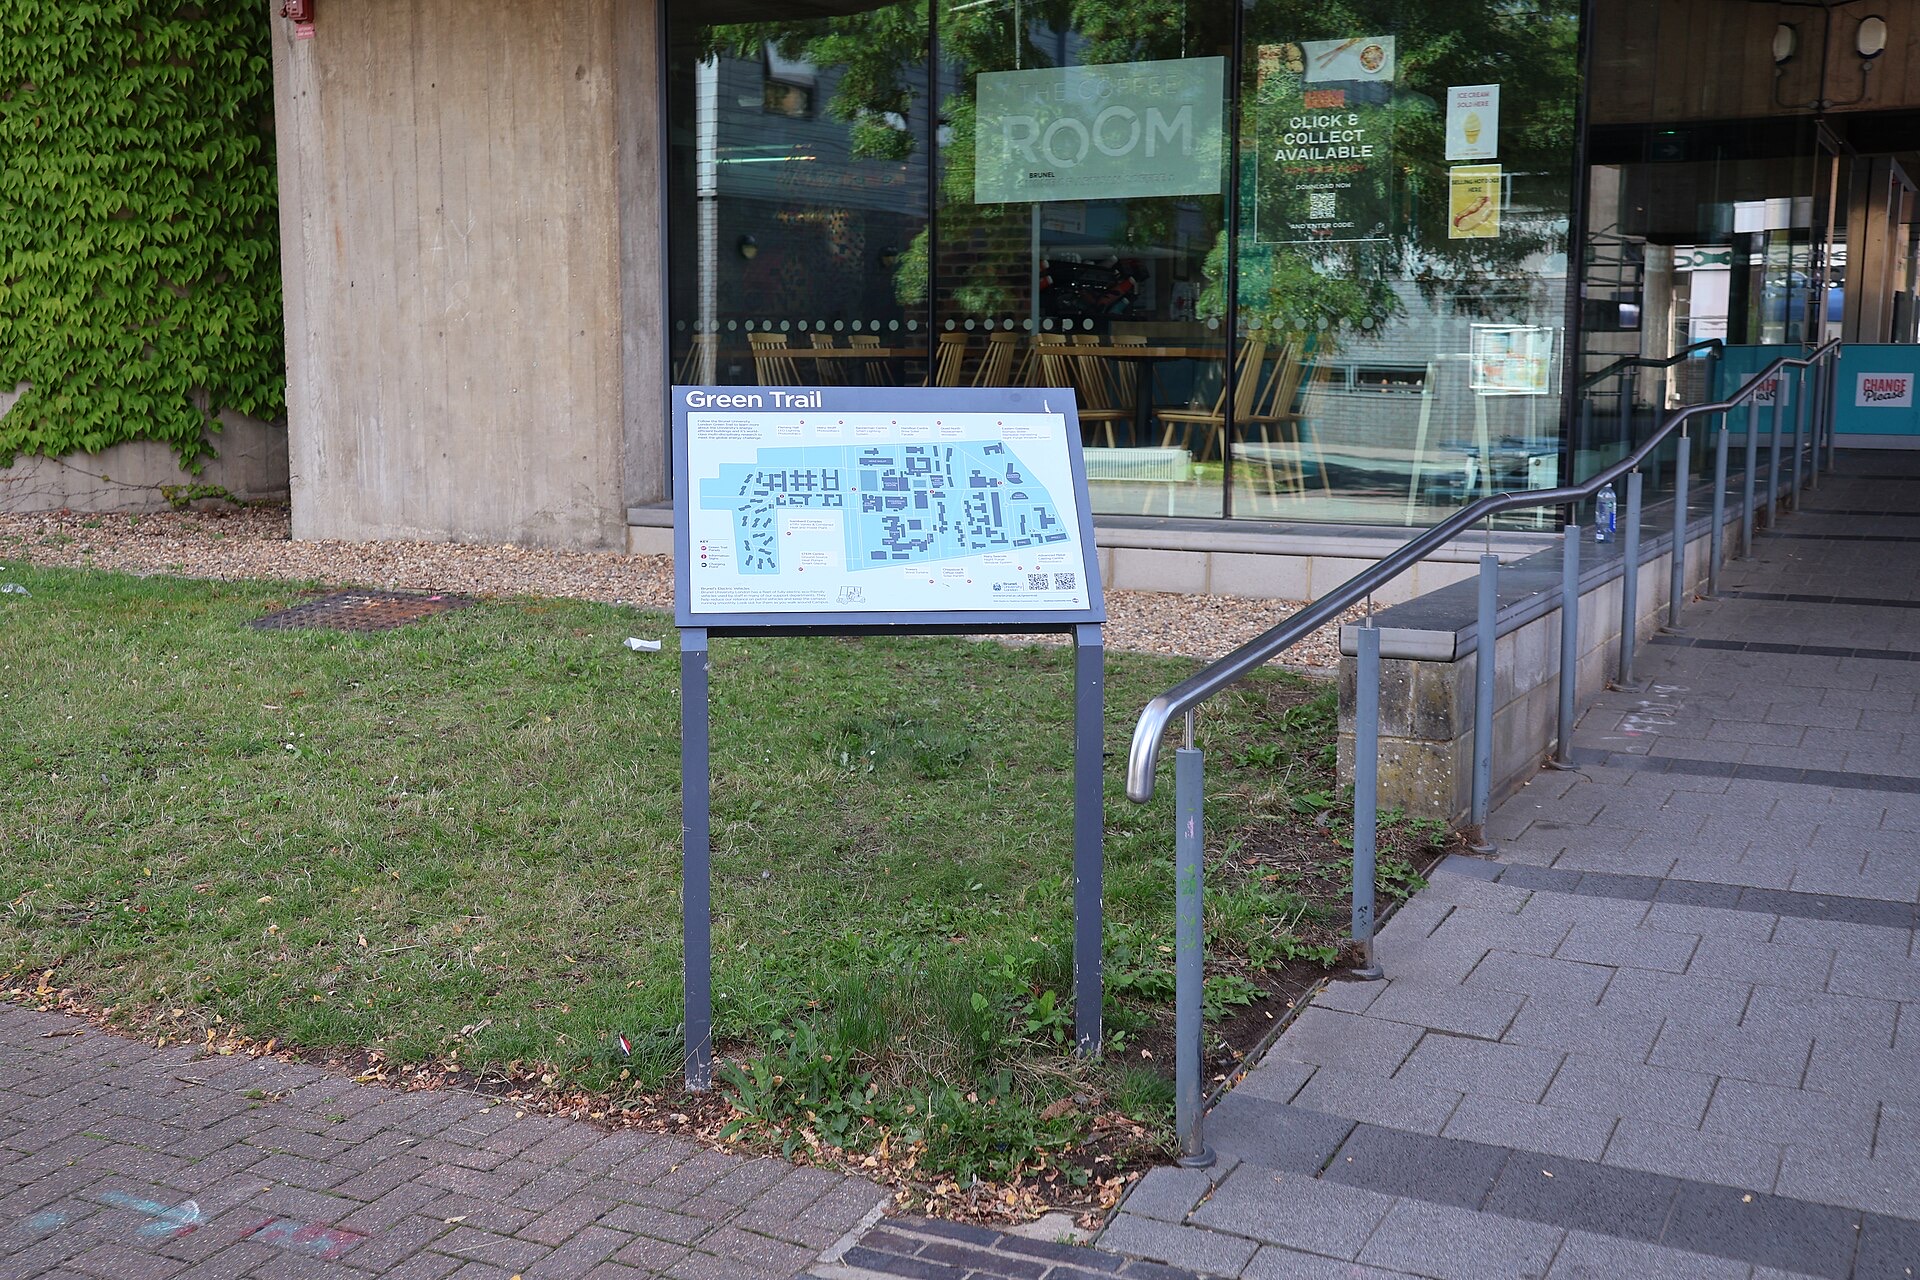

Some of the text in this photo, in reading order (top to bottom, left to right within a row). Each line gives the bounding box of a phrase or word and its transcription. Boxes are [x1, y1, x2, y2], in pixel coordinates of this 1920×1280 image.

[1019, 74, 1177, 101] THE COFFEE
[1290, 114, 1342, 128] CLICK
[1002, 104, 1194, 168] ROOM
[1284, 130, 1365, 145] COLLECT
[1274, 145, 1374, 161] AVAILABLE
[1864, 379, 1906, 392] CHANGE
[686, 390, 822, 408] Green Trail
[1864, 390, 1905, 402] Please
